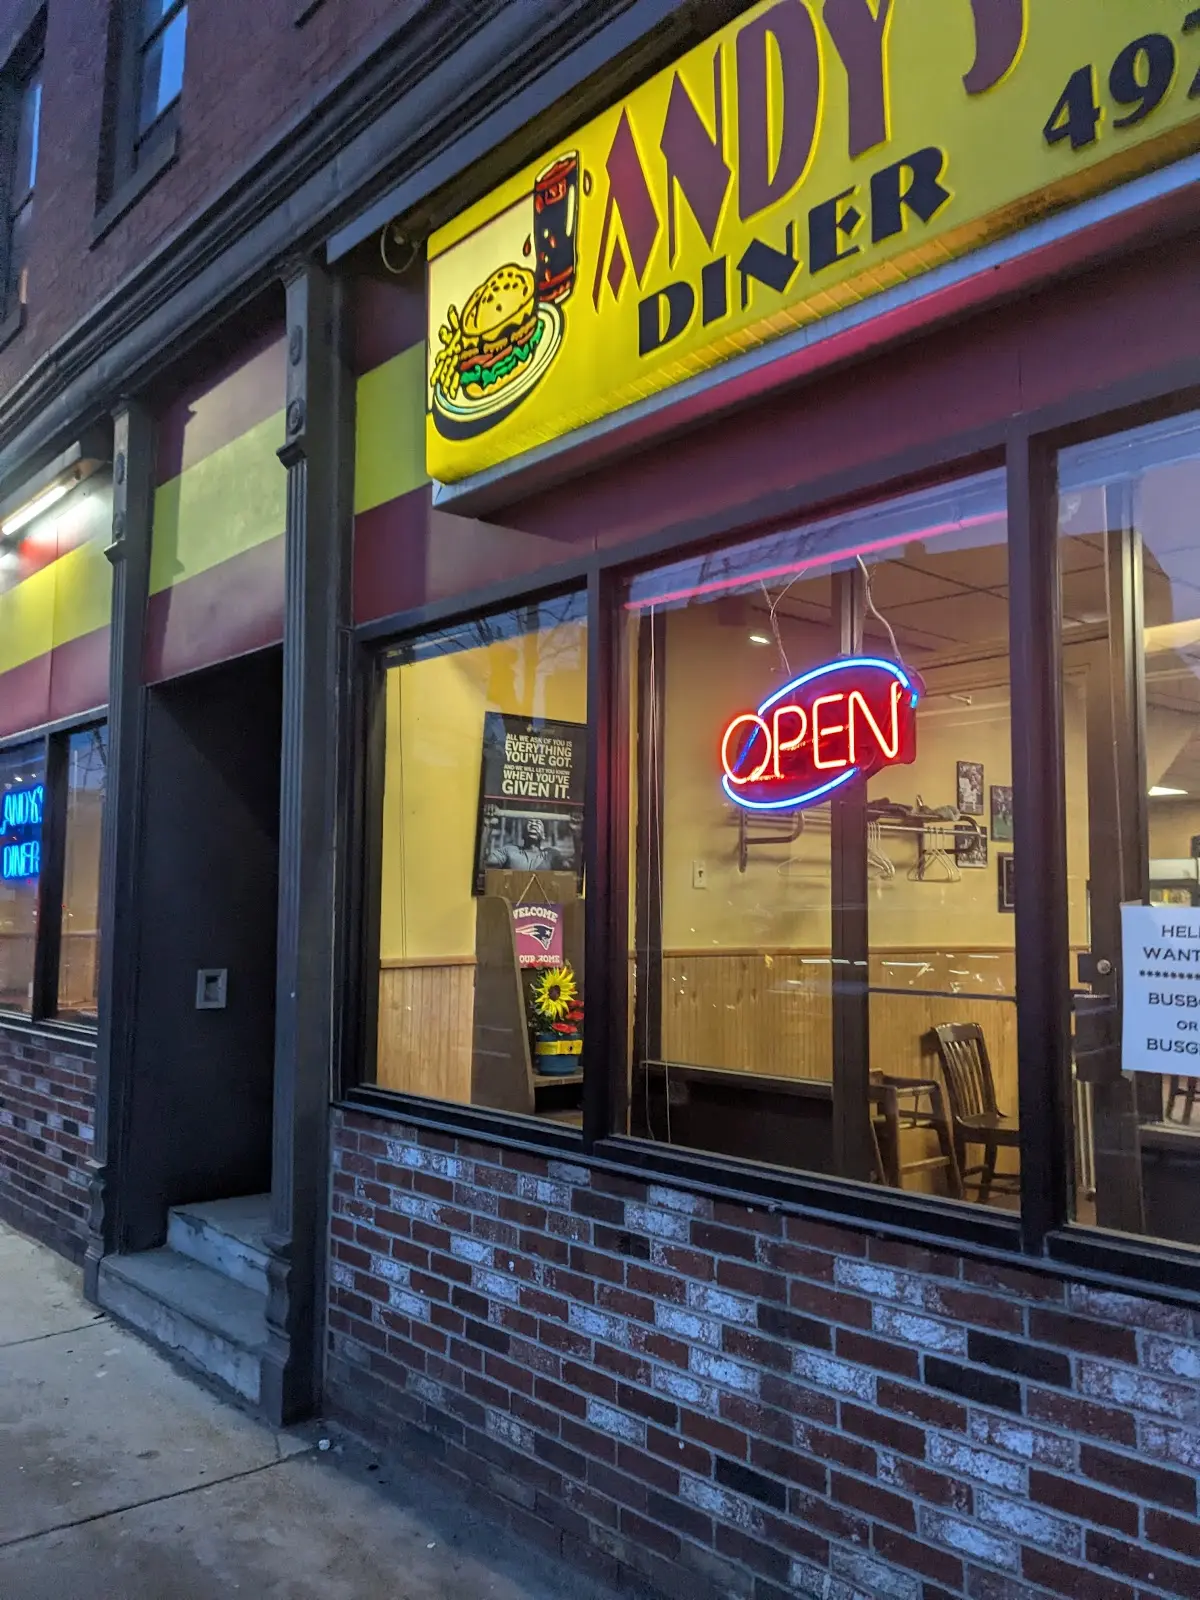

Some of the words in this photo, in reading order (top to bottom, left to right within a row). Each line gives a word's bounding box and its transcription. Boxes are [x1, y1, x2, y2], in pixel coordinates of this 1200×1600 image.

[639, 146, 949, 358] DINER
[506, 733, 518, 741] ALL
[519, 735, 529, 743] WE
[553, 739, 565, 747] YOU
[721, 681, 901, 784] OPEN
[505, 740, 572, 757] EVERYTHING
[505, 751, 546, 766] YOU'VE
[548, 756, 573, 768] GOT.
[503, 769, 533, 782] WHEN
[536, 772, 570, 785] YOU'VE
[501, 779, 550, 798] GIVEN
[554, 783, 571, 799] IT.
[3, 840, 40, 878] DINER
[1161, 924, 1200, 939] HEL
[1148, 991, 1200, 1008] BUSB
[1176, 1020, 1199, 1031] OR
[1146, 1037, 1200, 1055] BUSG
